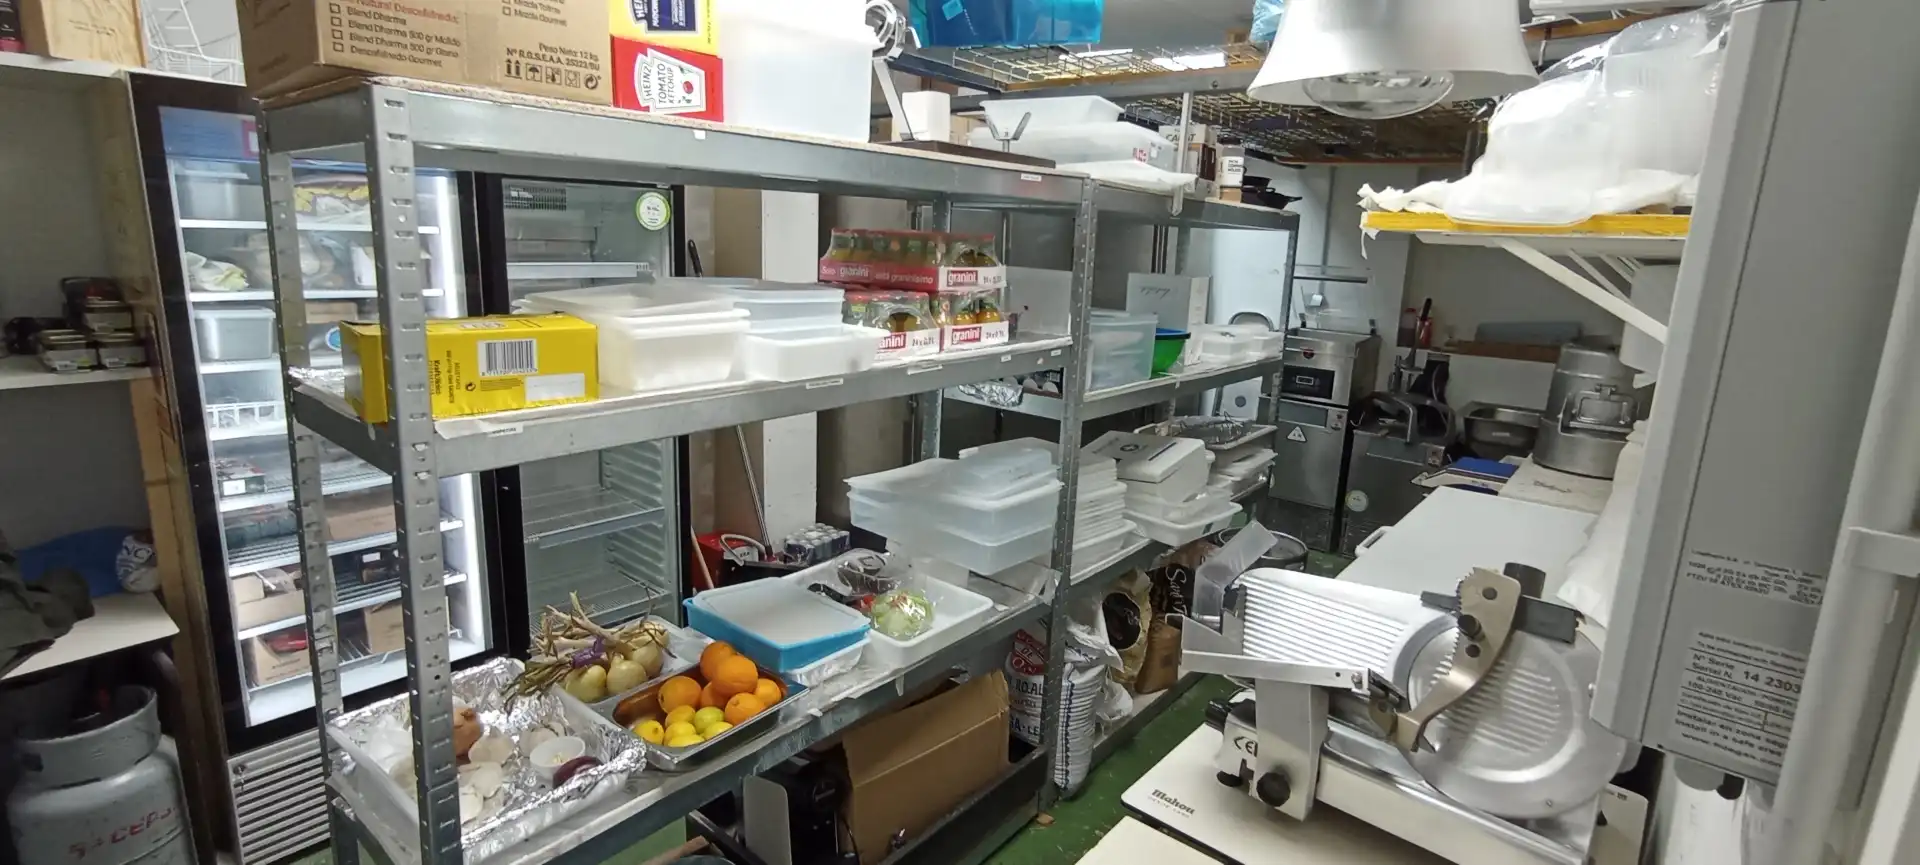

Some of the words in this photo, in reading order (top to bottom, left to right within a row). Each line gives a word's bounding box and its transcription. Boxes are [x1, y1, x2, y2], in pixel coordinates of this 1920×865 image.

[347, 6, 372, 18] Blend
[373, 11, 407, 25] Dharma
[539, 14, 567, 27] Gourmet
[348, 19, 373, 32] Blend
[375, 24, 407, 38] Dharma
[409, 30, 425, 40] 500
[349, 32, 374, 44] Blend
[376, 37, 408, 50] Dharma
[410, 42, 425, 53] 500
[539, 42, 558, 54] Peso
[408, 55, 442, 67] Gourmet
[643, 65, 652, 97] HEINZ
[657, 63, 667, 104] TOMATO
[1166, 133, 1197, 142] CAT
[839, 266, 870, 279] granini
[947, 270, 977, 286] granini
[879, 333, 905, 348] anini
[952, 326, 980, 345] granini
[1692, 662, 1721, 676] Serial
[1708, 657, 1735, 670] Serie
[1744, 671, 1760, 683] 14
[1764, 676, 1802, 694] 2303
[1677, 709, 1716, 726] Instalar
[1719, 724, 1732, 732] en
[1736, 729, 1761, 740] zona
[1675, 718, 1707, 733] Install
[1709, 729, 1720, 737] in
[1732, 736, 1755, 748] safe
[1758, 745, 1782, 758] area
[1151, 789, 1195, 815] Mahou
